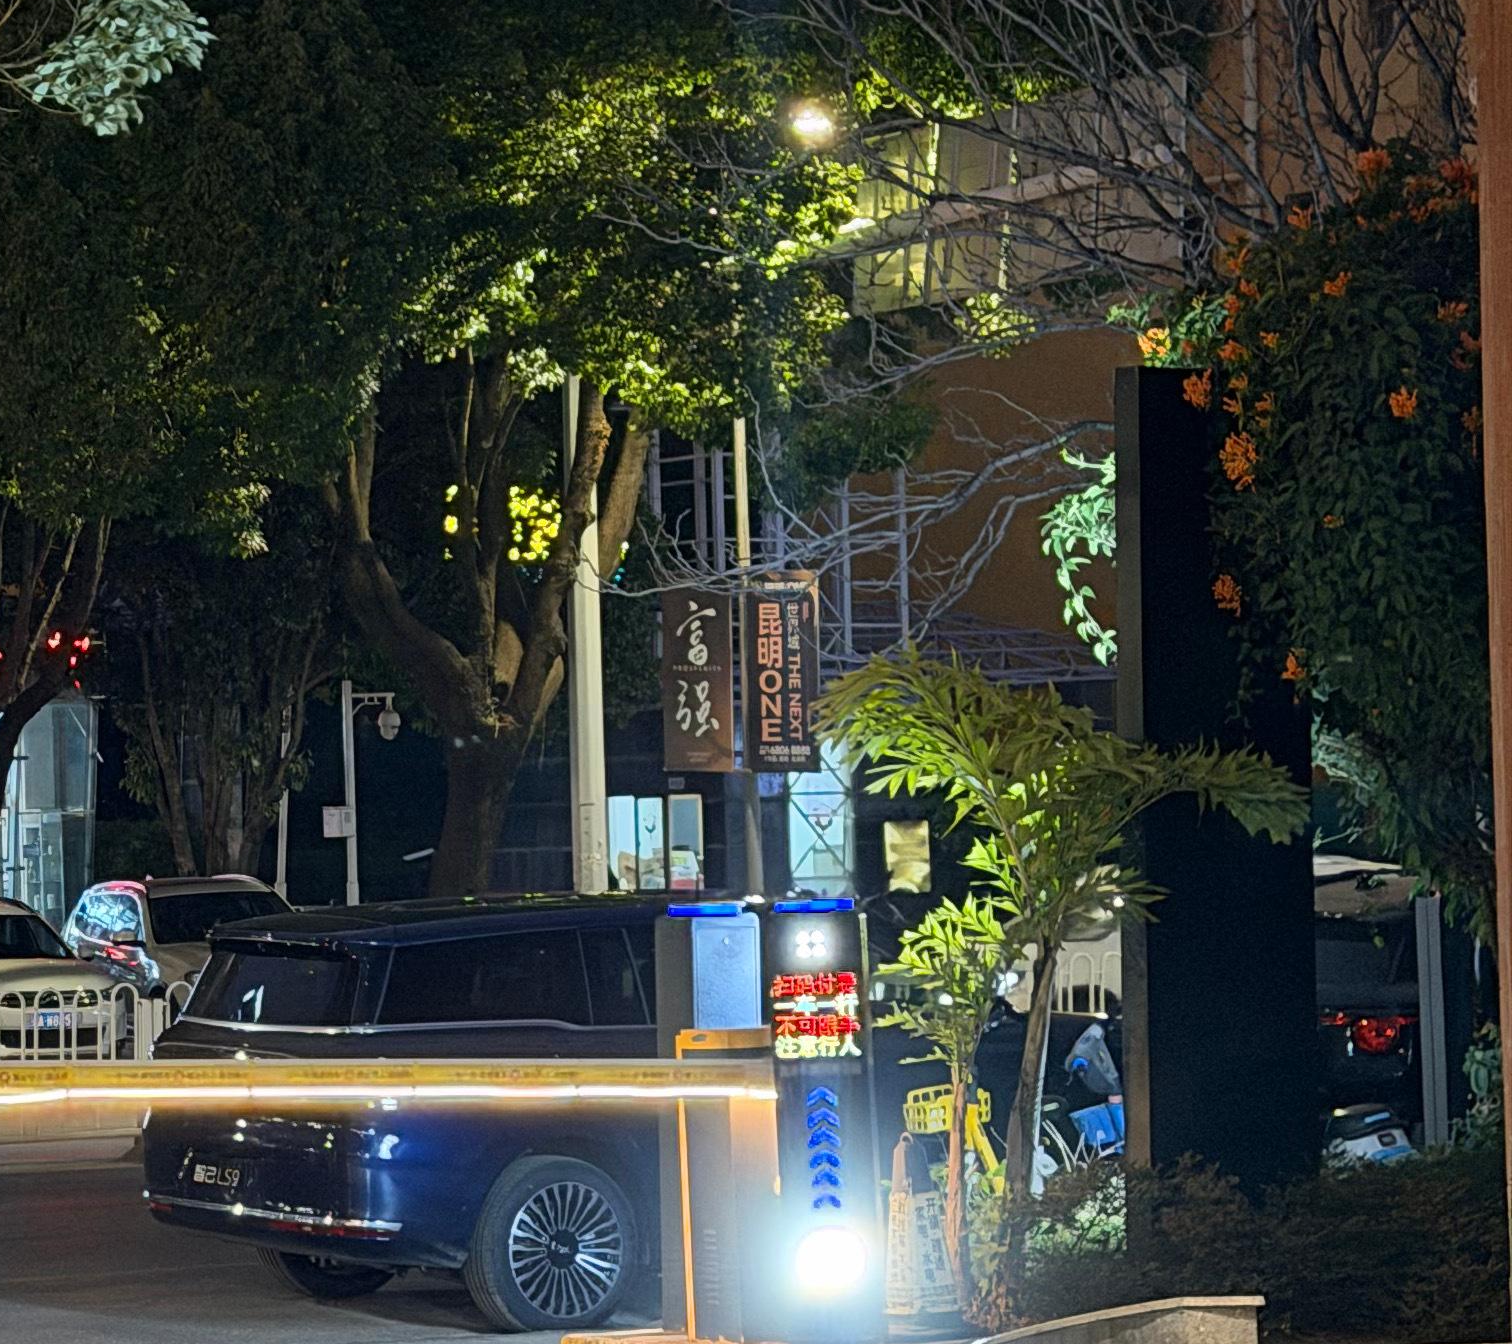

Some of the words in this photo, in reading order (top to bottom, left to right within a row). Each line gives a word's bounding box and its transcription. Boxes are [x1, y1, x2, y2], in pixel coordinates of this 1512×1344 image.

[788, 653, 802, 690] THE
[788, 693, 803, 742] NEXT
[775, 1034, 863, 1058] 注意行人
